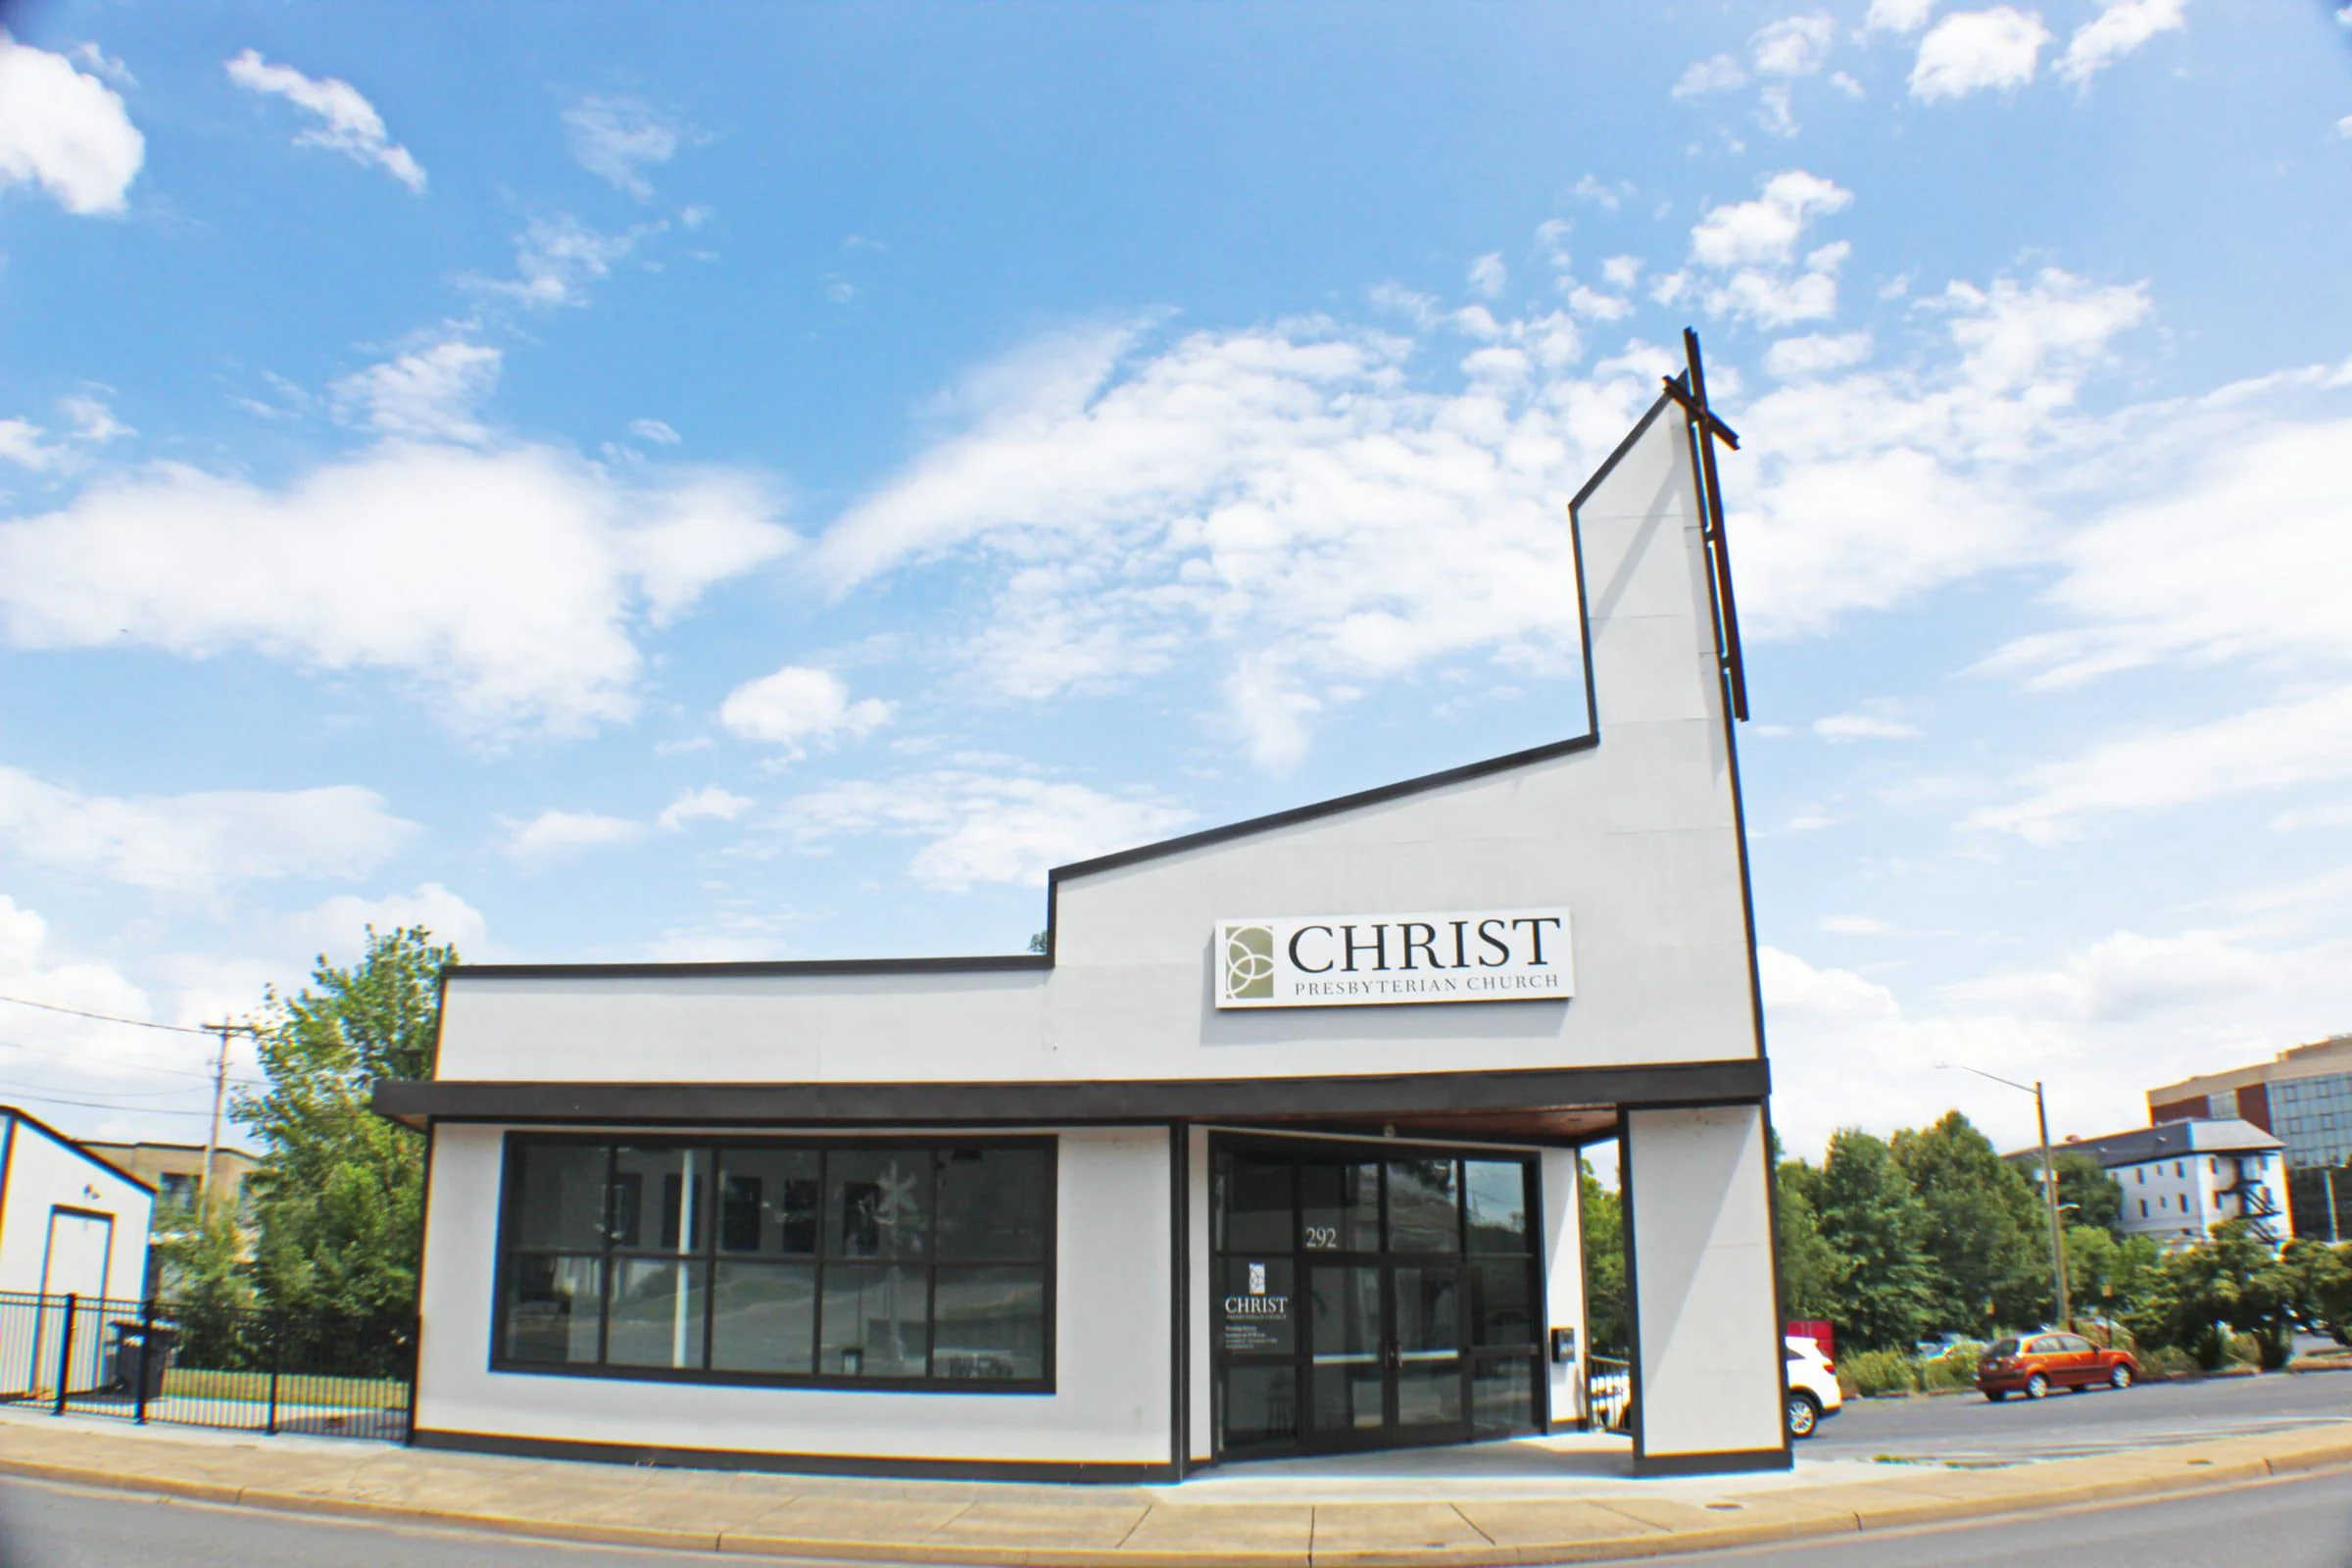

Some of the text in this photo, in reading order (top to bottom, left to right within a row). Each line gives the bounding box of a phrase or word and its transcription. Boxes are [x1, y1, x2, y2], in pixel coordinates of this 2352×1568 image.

[1288, 917, 1561, 974] CHRIST
[1295, 974, 1560, 997] PRESBYTERIAN CHURCH
[1306, 1227, 1337, 1249] 292
[1225, 1298, 1288, 1314] CHRIST
